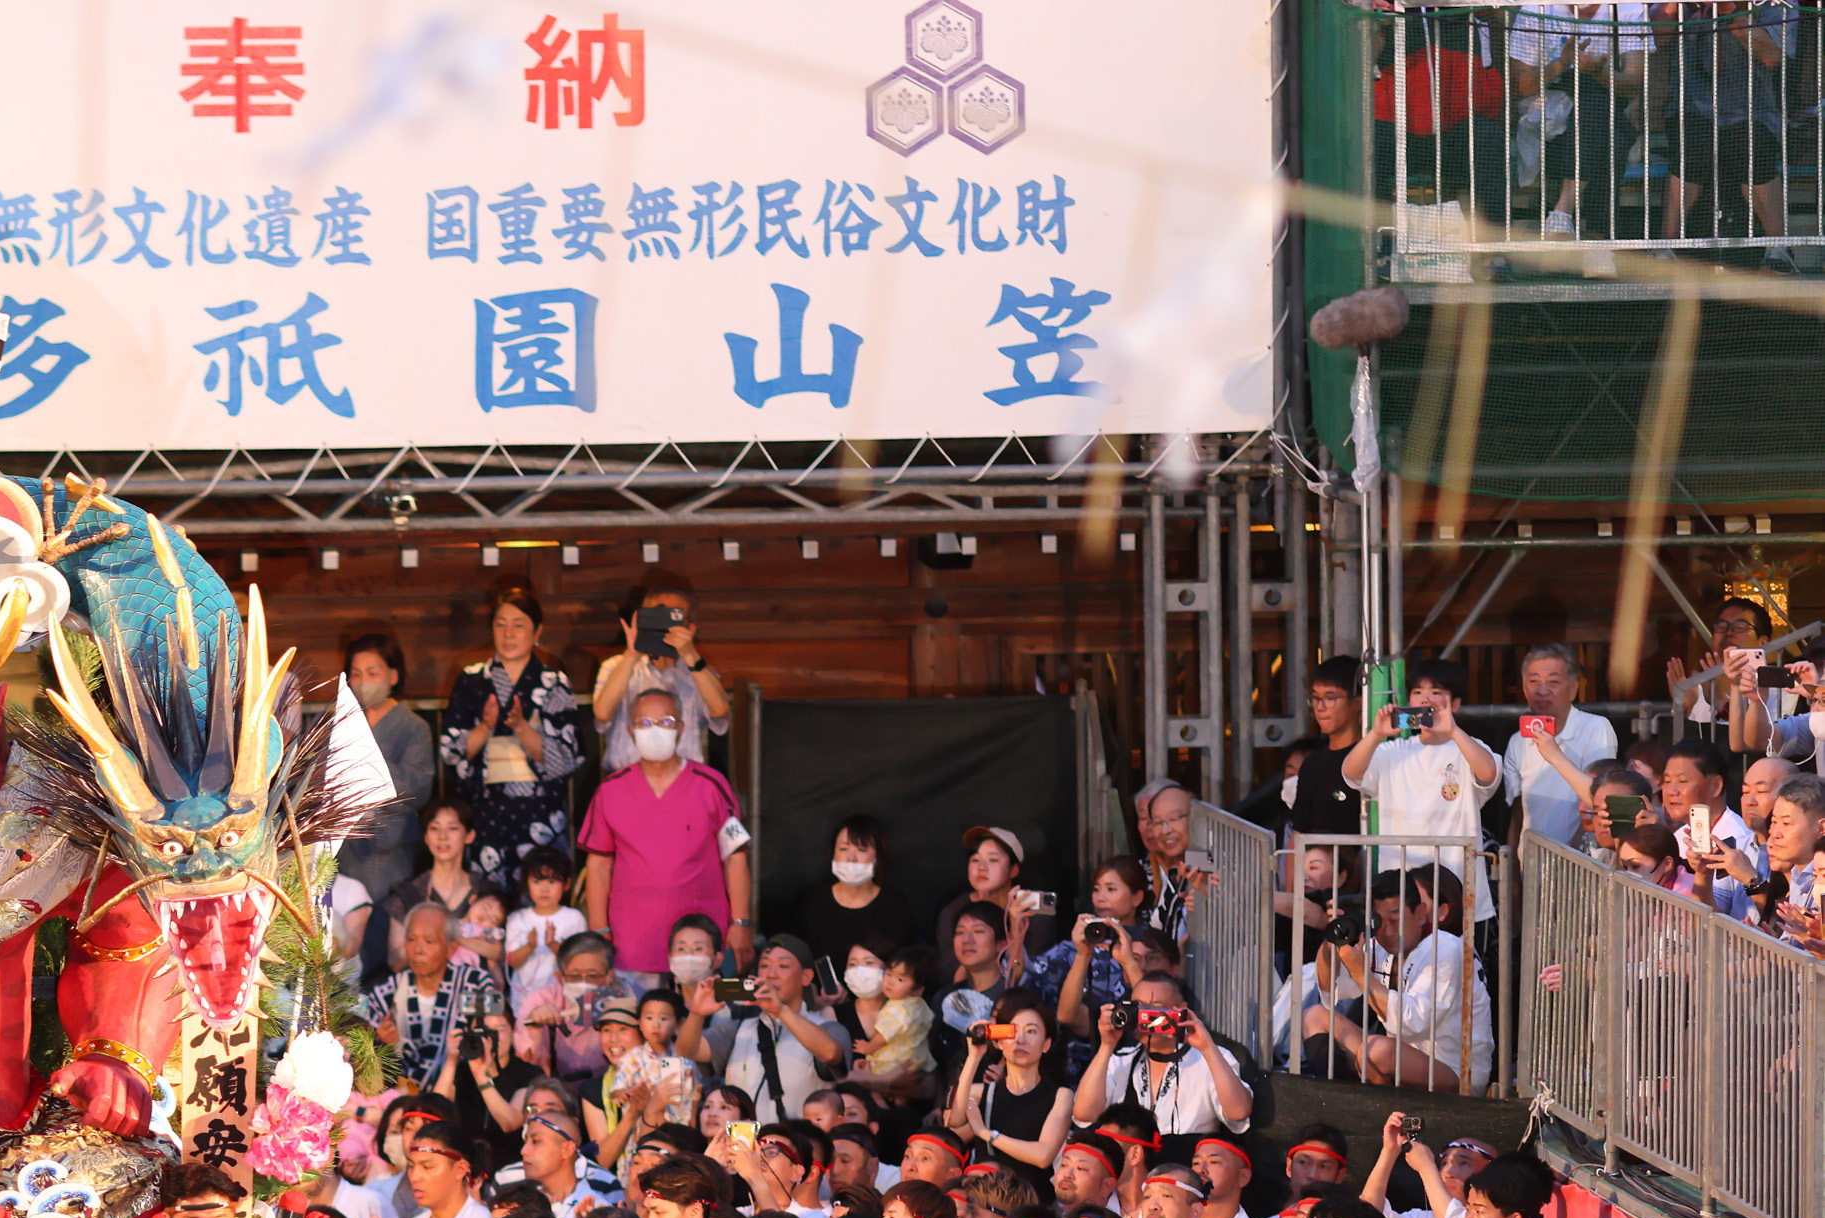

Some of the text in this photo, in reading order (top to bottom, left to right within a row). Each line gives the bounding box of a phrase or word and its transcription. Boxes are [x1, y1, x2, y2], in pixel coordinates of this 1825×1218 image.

[180, 13, 646, 133] 奉納
[426, 174, 1076, 264] 国重要無形民俗文化財
